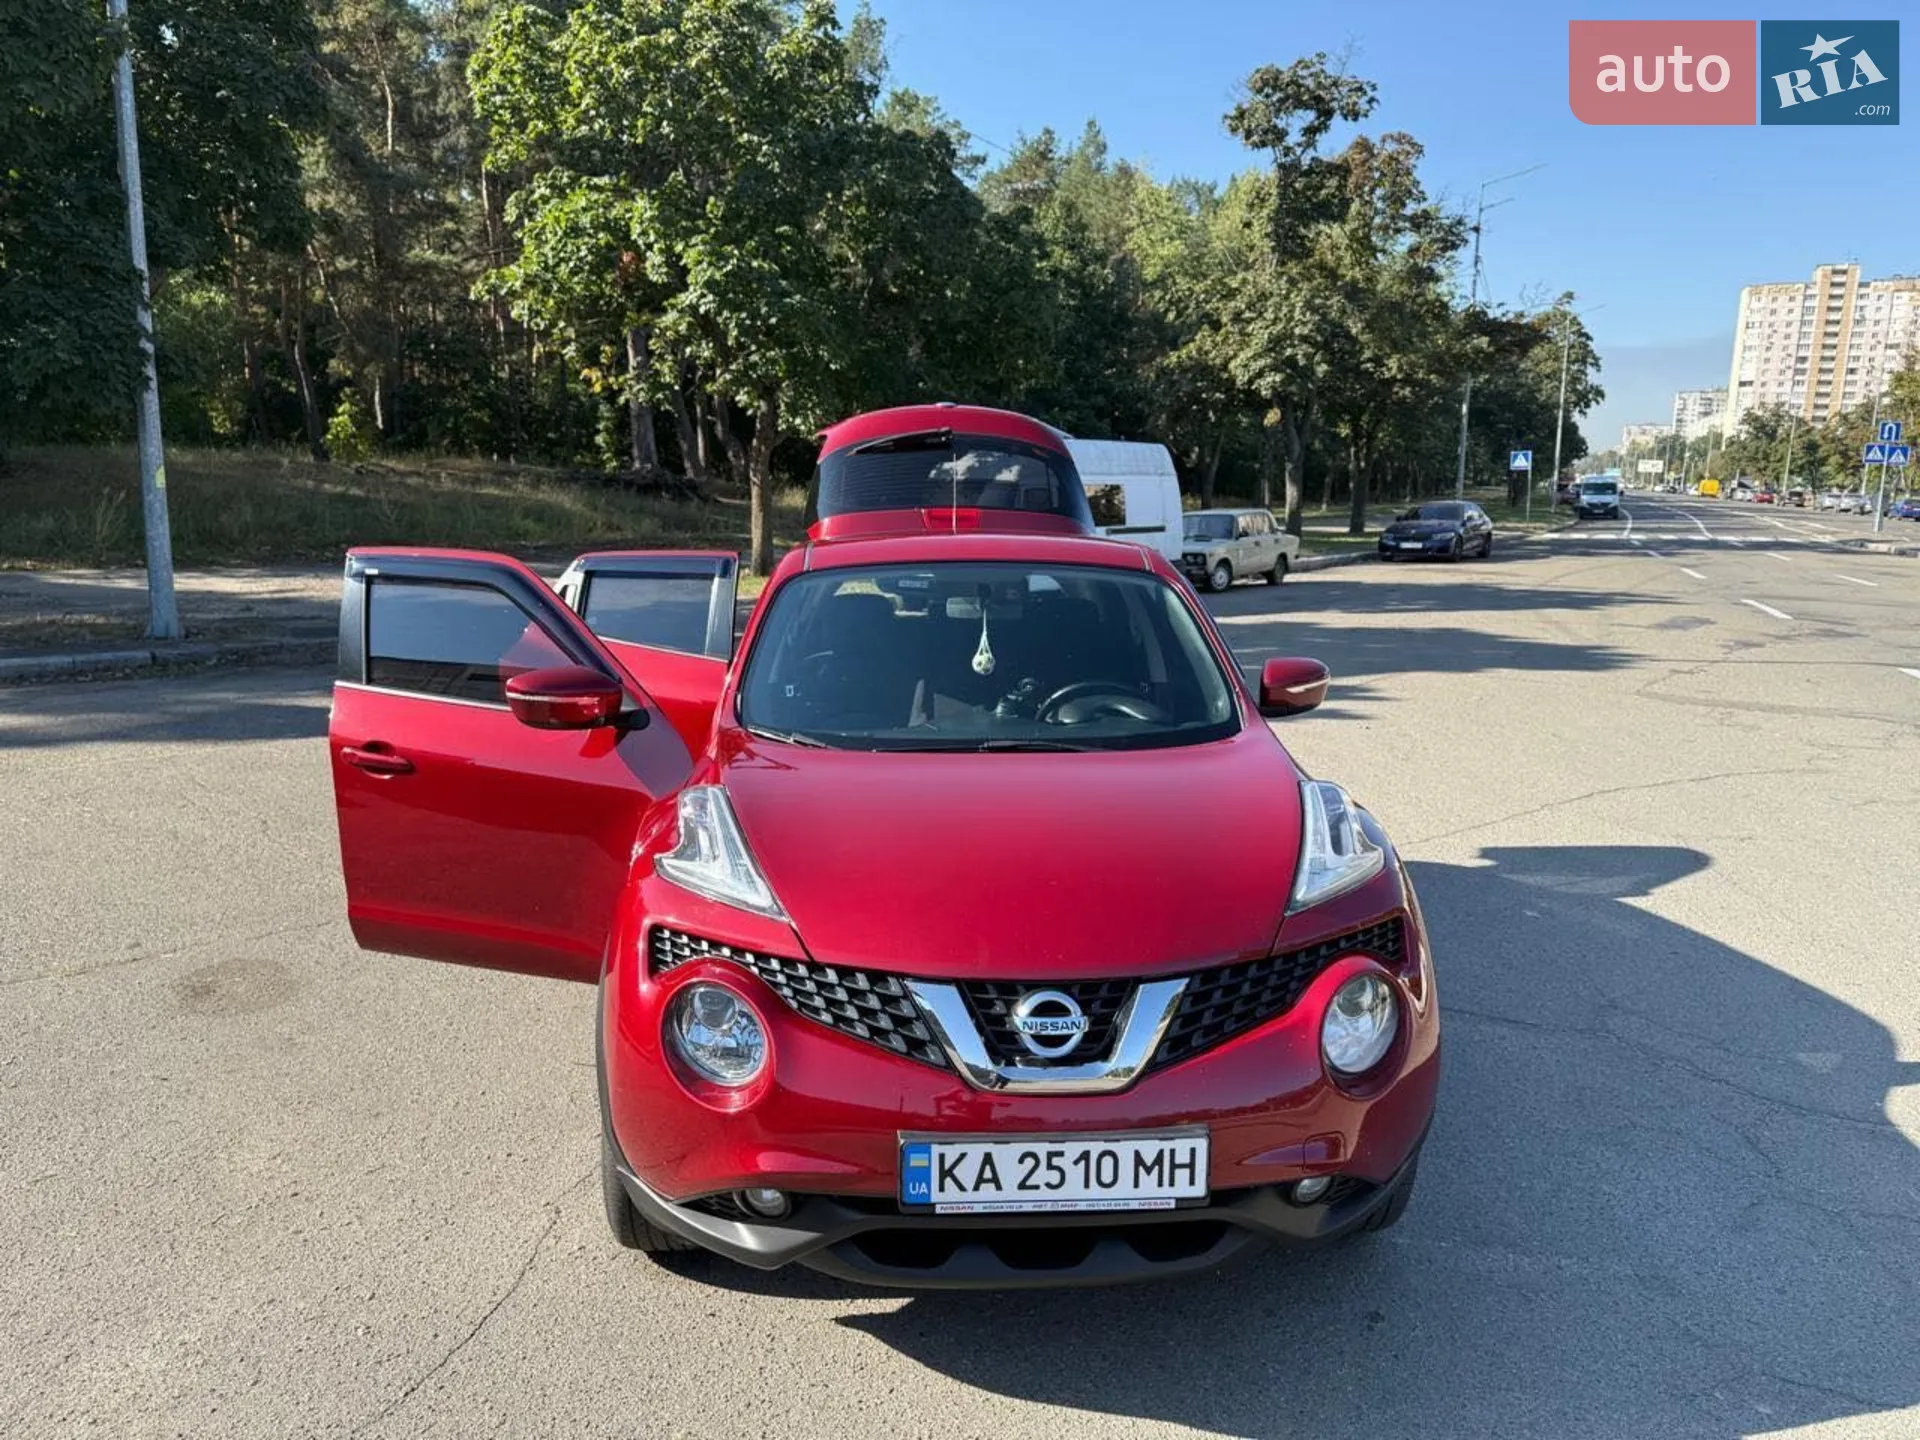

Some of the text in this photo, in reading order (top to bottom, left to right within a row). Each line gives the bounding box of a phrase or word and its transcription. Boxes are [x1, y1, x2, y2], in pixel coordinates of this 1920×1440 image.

[1022, 1020, 1081, 1032] NISSAN
[938, 1147, 1197, 1193] KA 2510 MH
[909, 1181, 928, 1195] UA
